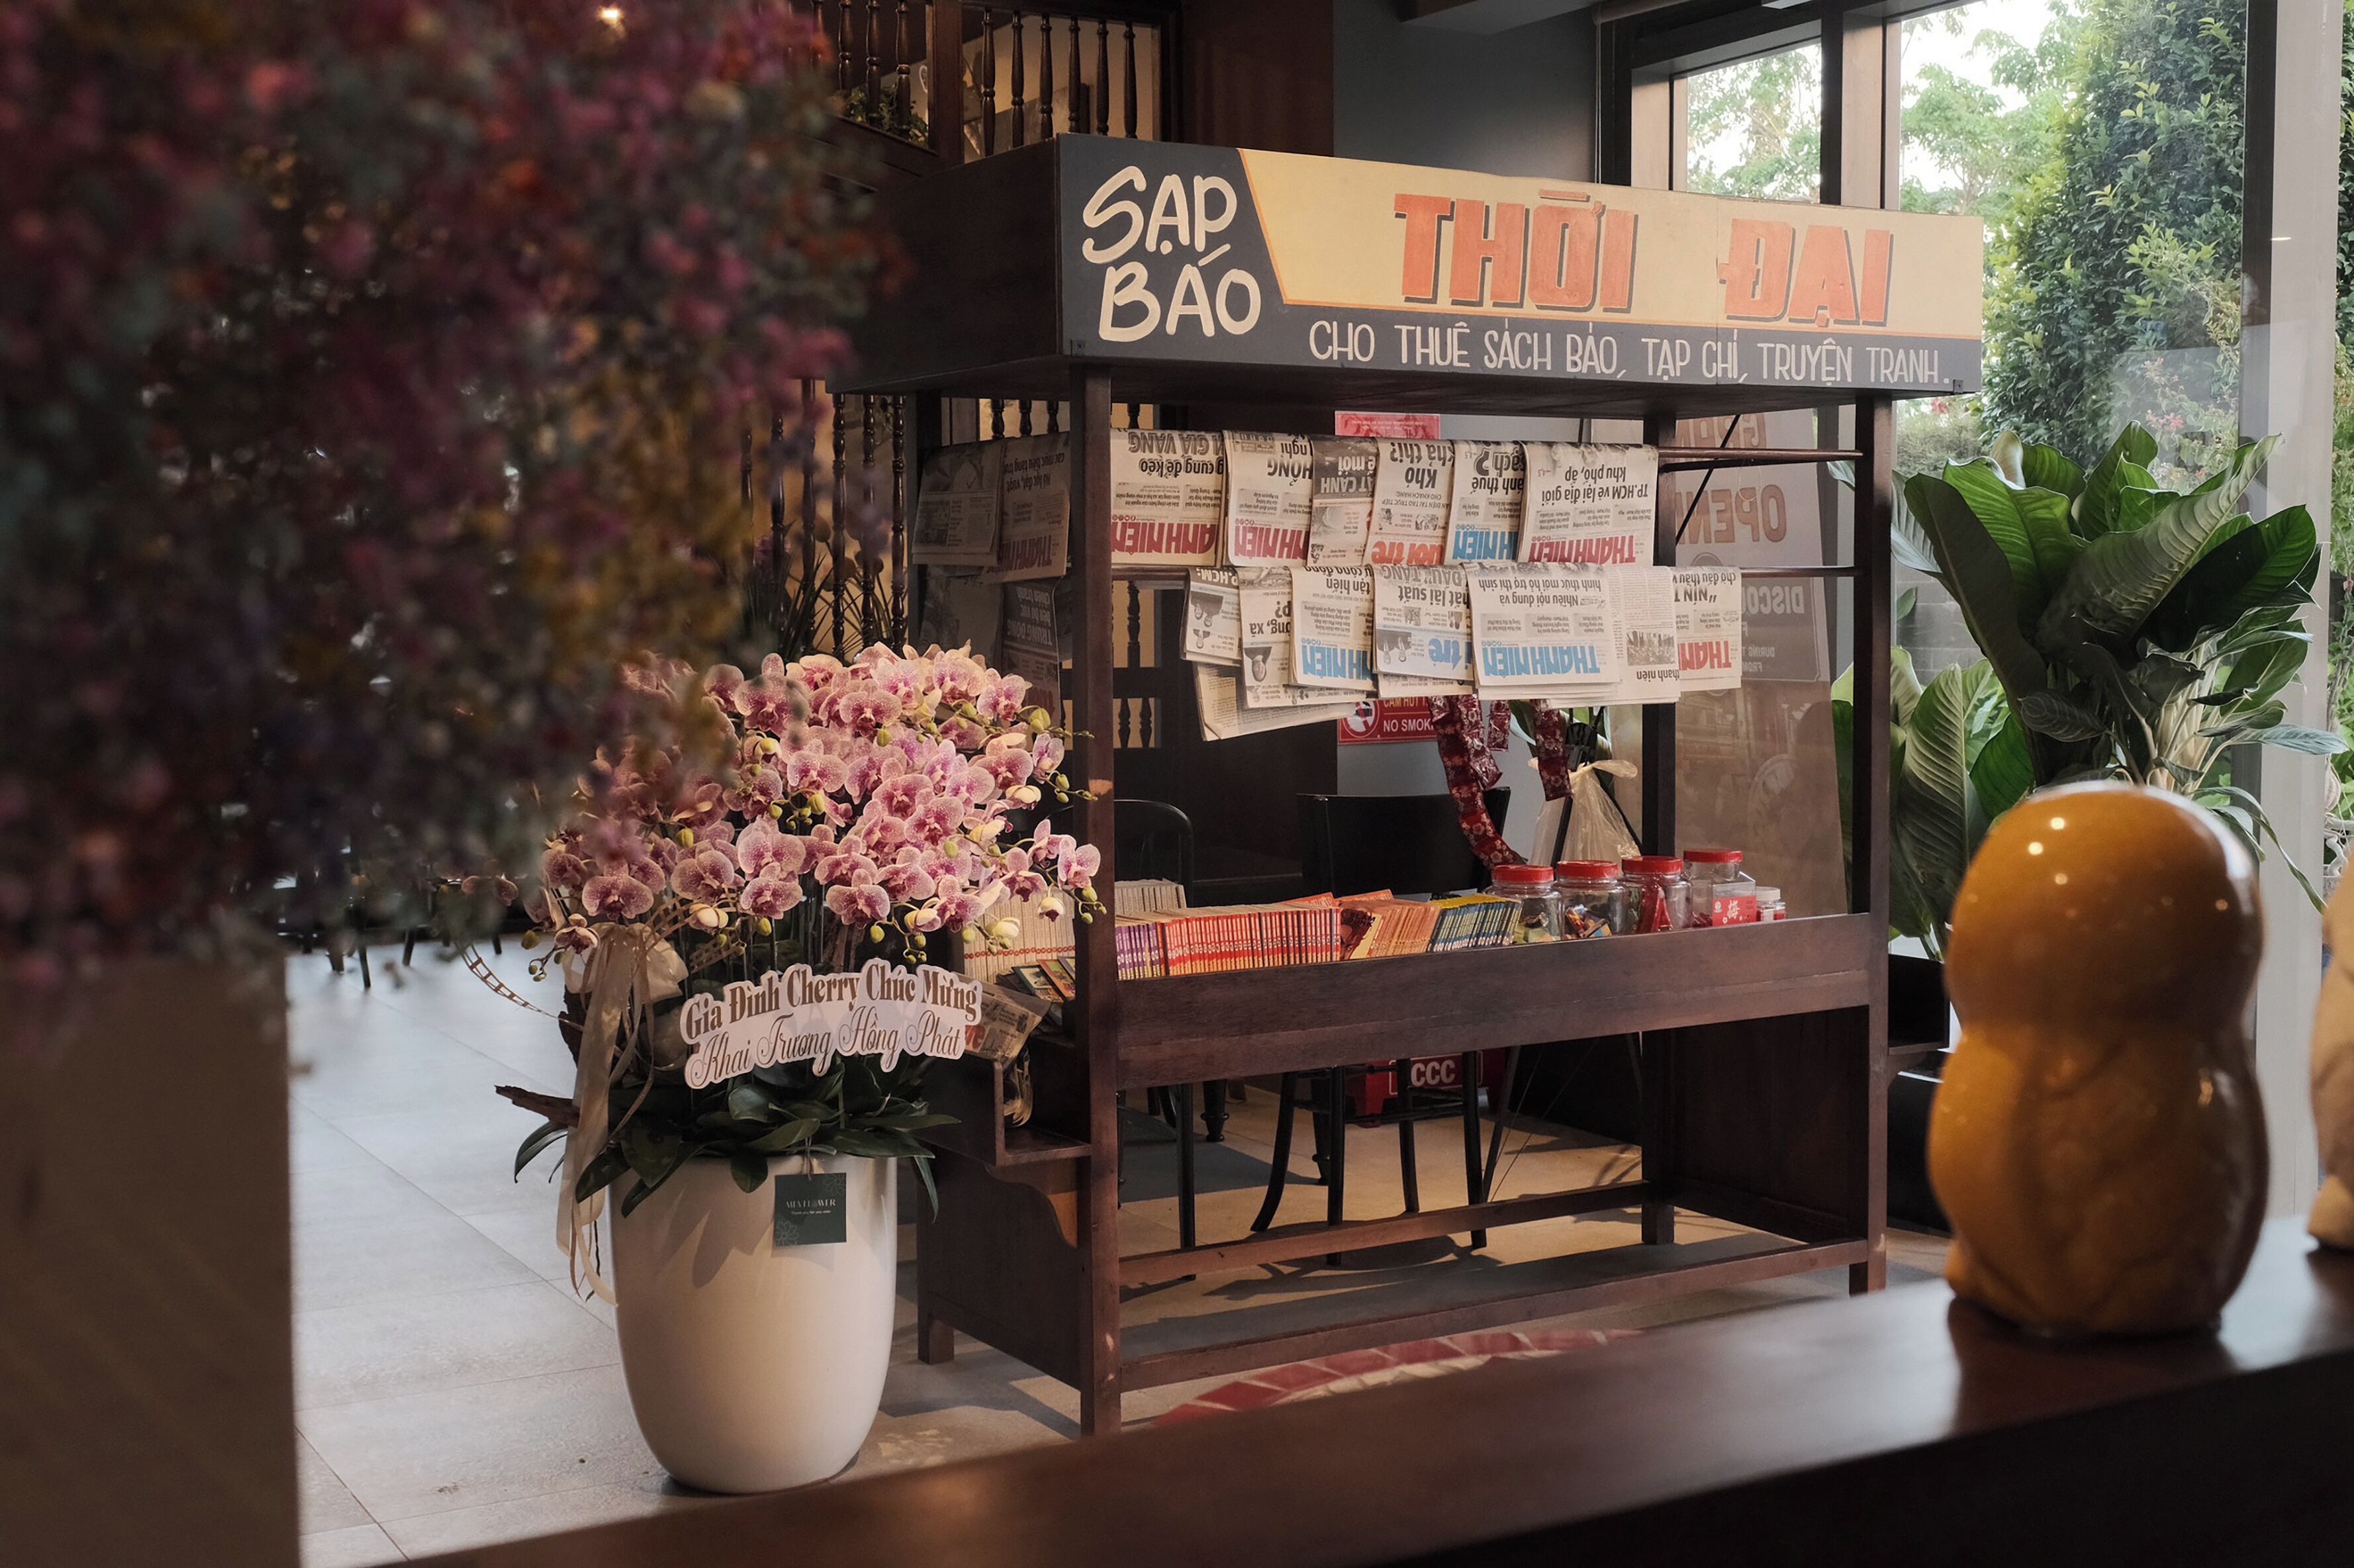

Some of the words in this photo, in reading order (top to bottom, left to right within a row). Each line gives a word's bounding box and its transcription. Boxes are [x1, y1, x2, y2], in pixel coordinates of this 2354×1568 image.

[1082, 165, 1238, 264] SẠP
[1717, 218, 1895, 328] ĐẠI
[1098, 244, 1260, 342] BÁO
[1309, 320, 1376, 362] CHO
[1393, 321, 1471, 369] THUÊ
[1484, 318, 1551, 372] SÁCH
[1566, 322, 1627, 379] BÁO,
[1641, 338, 1691, 381] TẠP
[1702, 328, 1748, 384] CHÍ,
[1757, 338, 1853, 387] TRUYỆN
[1865, 347, 1950, 384] TRANH.
[1127, 431, 1177, 459] VÀNG
[1179, 434, 1210, 460] GIÁ
[1389, 442, 1423, 464] thi?
[1139, 459, 1164, 478] kéo
[1186, 458, 1214, 475] cung
[1337, 455, 1365, 476] mới
[1607, 467, 1626, 483] khu
[1405, 467, 1438, 490] Khó
[1564, 465, 1578, 486] ấp
[1581, 465, 1605, 486] phố,
[1321, 476, 1357, 496] CÁNH
[1471, 477, 1499, 494] thuế
[1564, 485, 1580, 504] địa
[1582, 484, 1596, 503] lại
[1613, 483, 1648, 499] TP.HCM
[1542, 486, 1562, 506] giới
[1452, 531, 1498, 563] NIÊN
[1575, 535, 1636, 565] THANH
[1381, 565, 1421, 584] TĂNG
[1514, 576, 1527, 590] trợ
[1326, 578, 1350, 595] hiến
[1352, 578, 1370, 595] tận
[1397, 585, 1427, 604] suất
[1478, 579, 1497, 592] sinh
[1542, 580, 1559, 592] mới
[1560, 579, 1580, 592] thức
[1581, 580, 1601, 592] hình
[1430, 589, 1446, 607] lãi
[1499, 595, 1510, 607] và
[1512, 592, 1534, 608] dung
[1536, 592, 1550, 608] nội
[1552, 594, 1579, 608] Nhiều
[1027, 625, 1053, 646] TRUNG
[1249, 622, 1264, 638] xã
[1301, 645, 1347, 679] NIÊN
[1428, 638, 1462, 670] trẻ
[1482, 646, 1531, 678] NIÊN
[1530, 645, 1601, 675] THANH
[1677, 640, 1732, 671] THAN
[1636, 670, 1656, 682] niên
[1658, 669, 1679, 682] thanh
[1383, 719, 1399, 733] NO
[685, 997, 722, 1040] Gia
[729, 976, 780, 1025] Đình
[786, 968, 861, 1011] Cherry
[866, 963, 916, 1001] Chúc
[921, 968, 978, 1022] Mừng
[693, 1031, 751, 1084] Khai
[756, 1011, 833, 1076] Trương
[838, 1005, 902, 1070] Hồng
[905, 1009, 961, 1055] Phát
